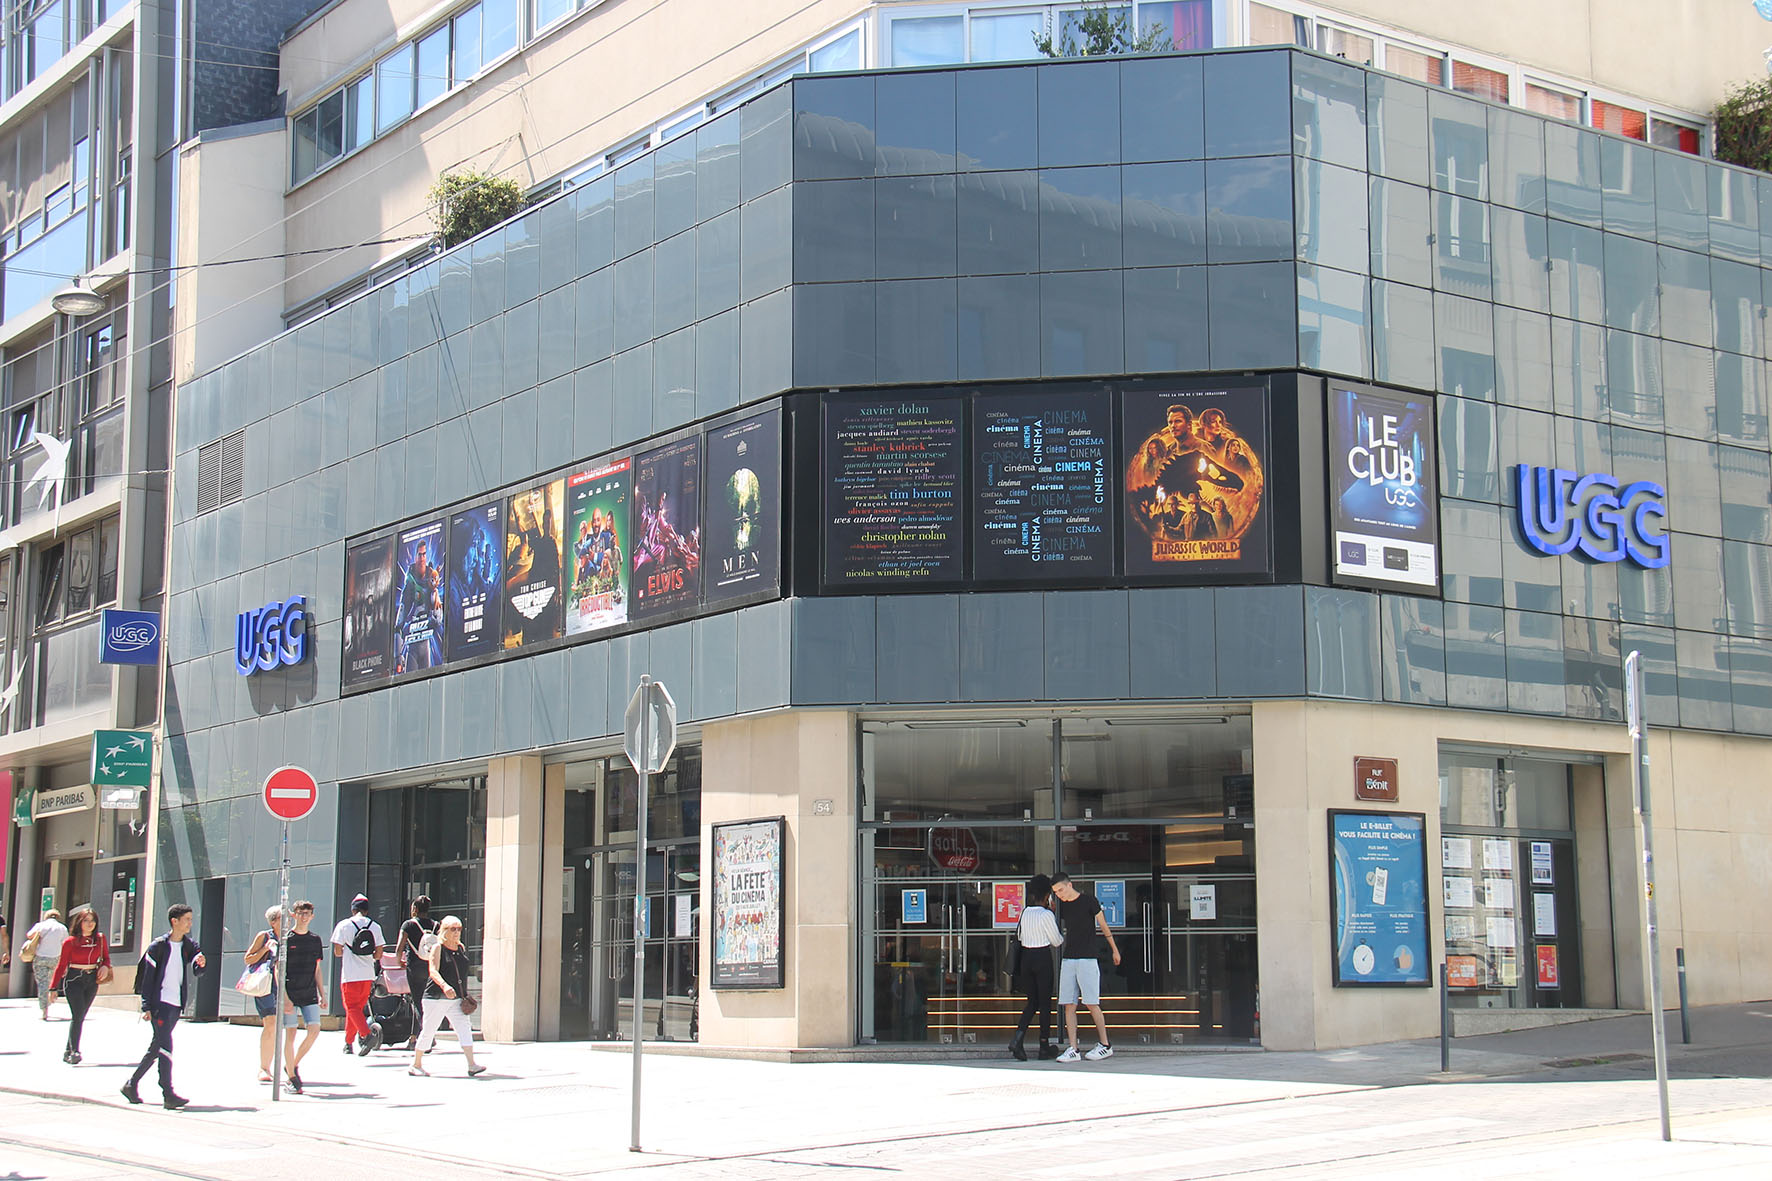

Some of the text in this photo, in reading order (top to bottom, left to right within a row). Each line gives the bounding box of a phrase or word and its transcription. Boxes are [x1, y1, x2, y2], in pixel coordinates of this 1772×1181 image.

[860, 404, 929, 416] xavier dolan
[1044, 410, 1087, 424] CINEMA
[836, 430, 866, 440] jacques
[868, 428, 898, 436] audiard
[1368, 414, 1398, 448] LE
[993, 440, 1018, 448] cinéma
[1033, 420, 1042, 464] CINEMA
[1069, 437, 1104, 446] CINÉMA
[854, 444, 886, 454] stanley
[889, 442, 926, 451] kubrick
[1046, 445, 1067, 454] cinéma
[1070, 448, 1102, 458] CINEMA
[876, 452, 907, 460] martin
[906, 467, 930, 476] lynch
[1004, 464, 1036, 472] cinéma
[1056, 462, 1092, 472] CINEMA
[1348, 446, 1416, 486] CLUB
[1095, 458, 1104, 504] CINEMA
[890, 488, 952, 498] tim burton
[1385, 487, 1416, 508] UGC
[1031, 494, 1072, 506] CINEMA
[1073, 506, 1103, 514] cinéma
[854, 514, 896, 522] anderson
[898, 516, 917, 524] pedro
[1514, 464, 1670, 569] UGC
[984, 521, 1016, 529] cinéma
[1066, 524, 1101, 533] CINÉMA
[861, 530, 946, 544] christopher nolan
[1032, 516, 1040, 562] CINEMA
[1042, 537, 1087, 551] CINEMA
[1155, 541, 1240, 555] JURASSIC WORLD
[723, 551, 760, 573] MEN
[908, 560, 922, 568] joel
[846, 568, 930, 578] nicolas winding refn
[648, 568, 684, 596] ELVIS
[112, 626, 150, 644] UGC
[235, 595, 306, 676] UGC
[352, 654, 382, 671] BLACK PHONE
[41, 792, 84, 810] BNP PARIBAS
[818, 803, 830, 812] 54
[1390, 832, 1412, 840] CINÉMA
[732, 874, 742, 890] LA
[732, 892, 740, 904] DU
